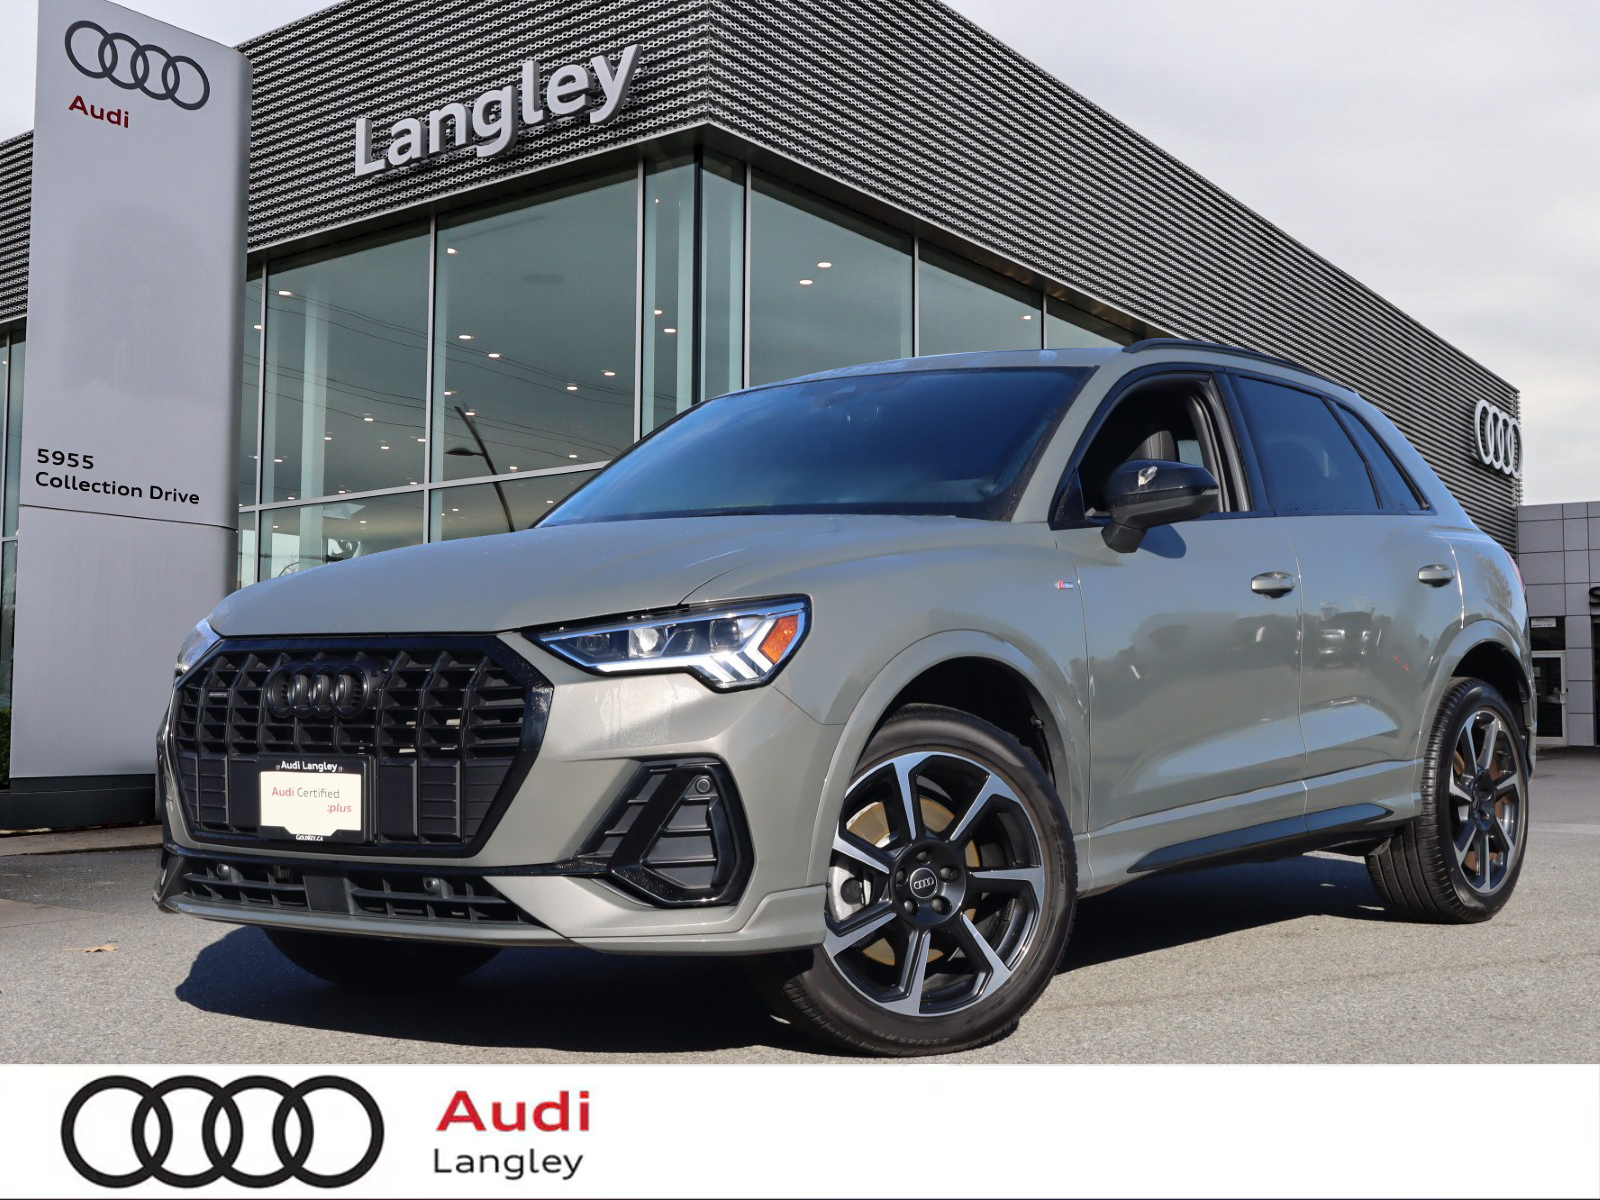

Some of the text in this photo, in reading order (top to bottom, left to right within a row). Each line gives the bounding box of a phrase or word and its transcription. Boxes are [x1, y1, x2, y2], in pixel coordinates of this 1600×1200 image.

[68, 95, 129, 128] Audi
[354, 43, 644, 177] Langley
[37, 448, 94, 470] 5955
[35, 471, 200, 504] Collection Drive
[281, 760, 338, 772] Audi Langley
[272, 786, 340, 799] Audi Certified
